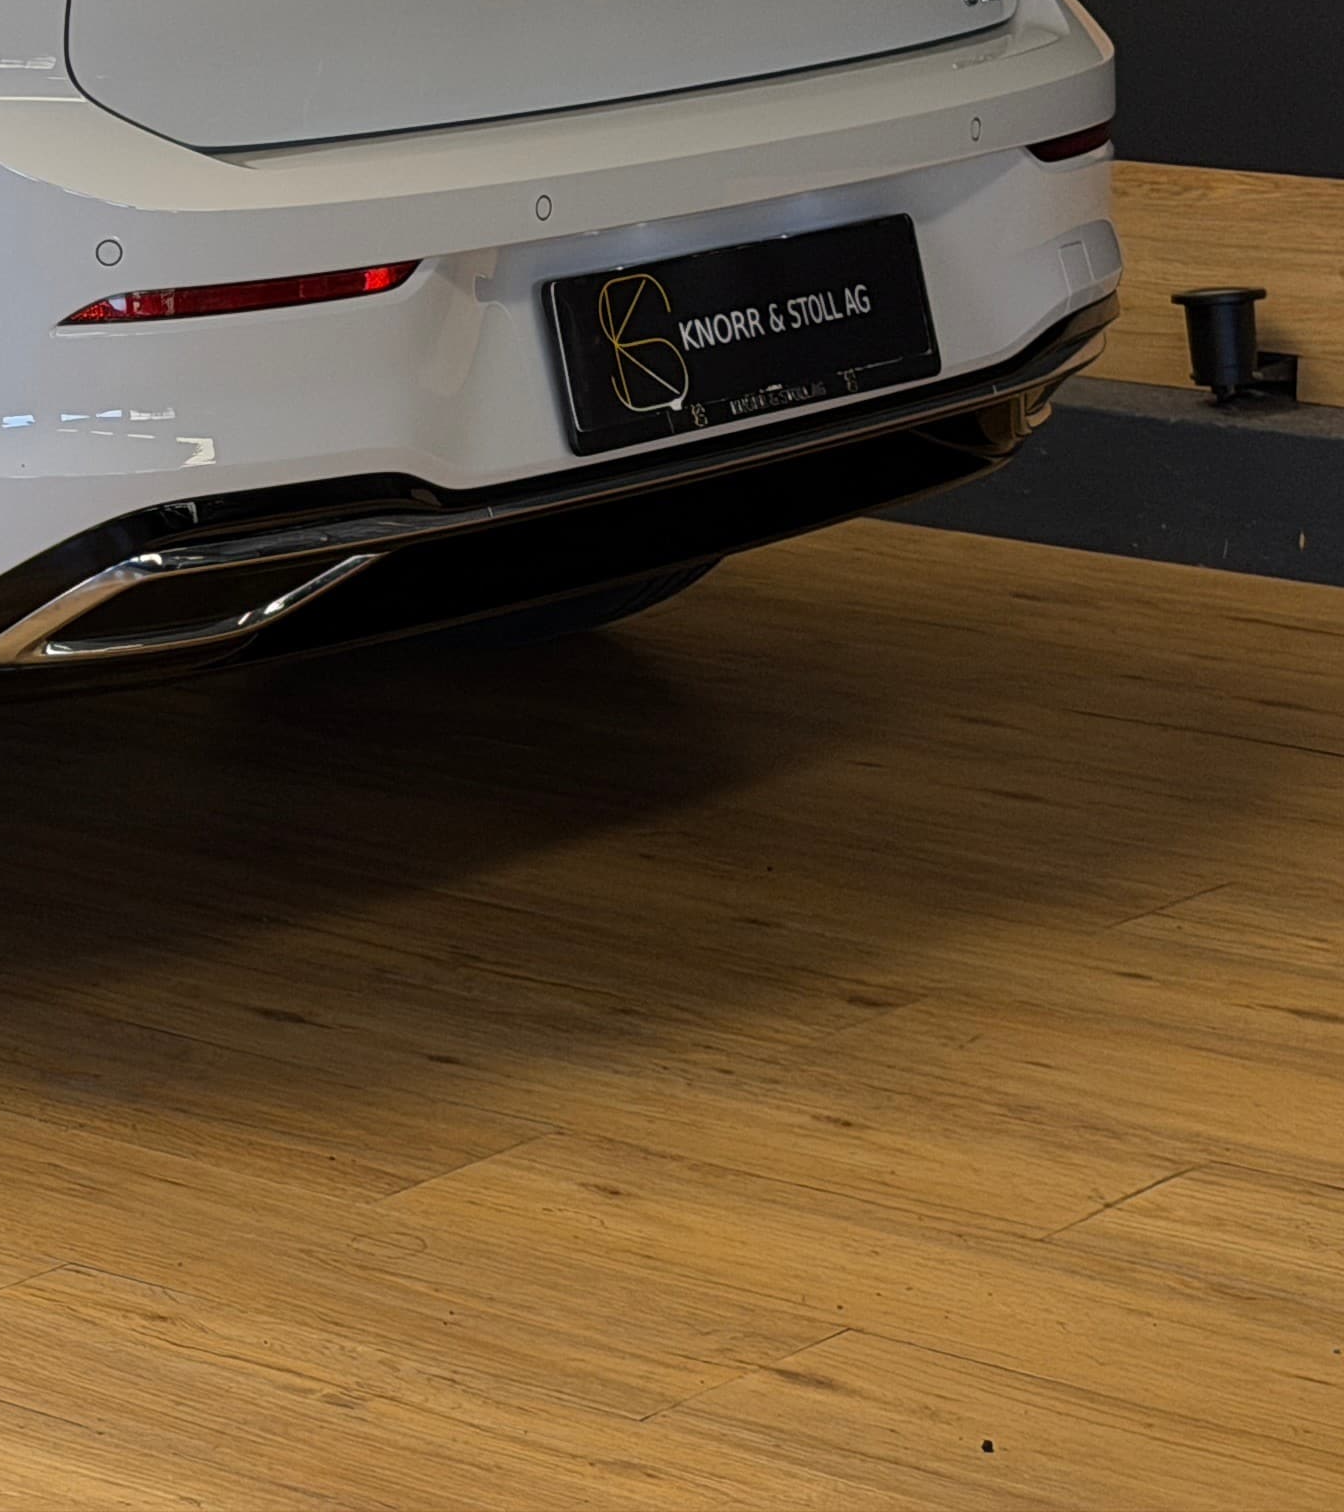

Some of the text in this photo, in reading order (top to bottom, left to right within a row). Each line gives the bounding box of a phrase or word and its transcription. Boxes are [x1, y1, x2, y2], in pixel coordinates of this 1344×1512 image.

[678, 284, 871, 351] KNORR & STOLL AG
